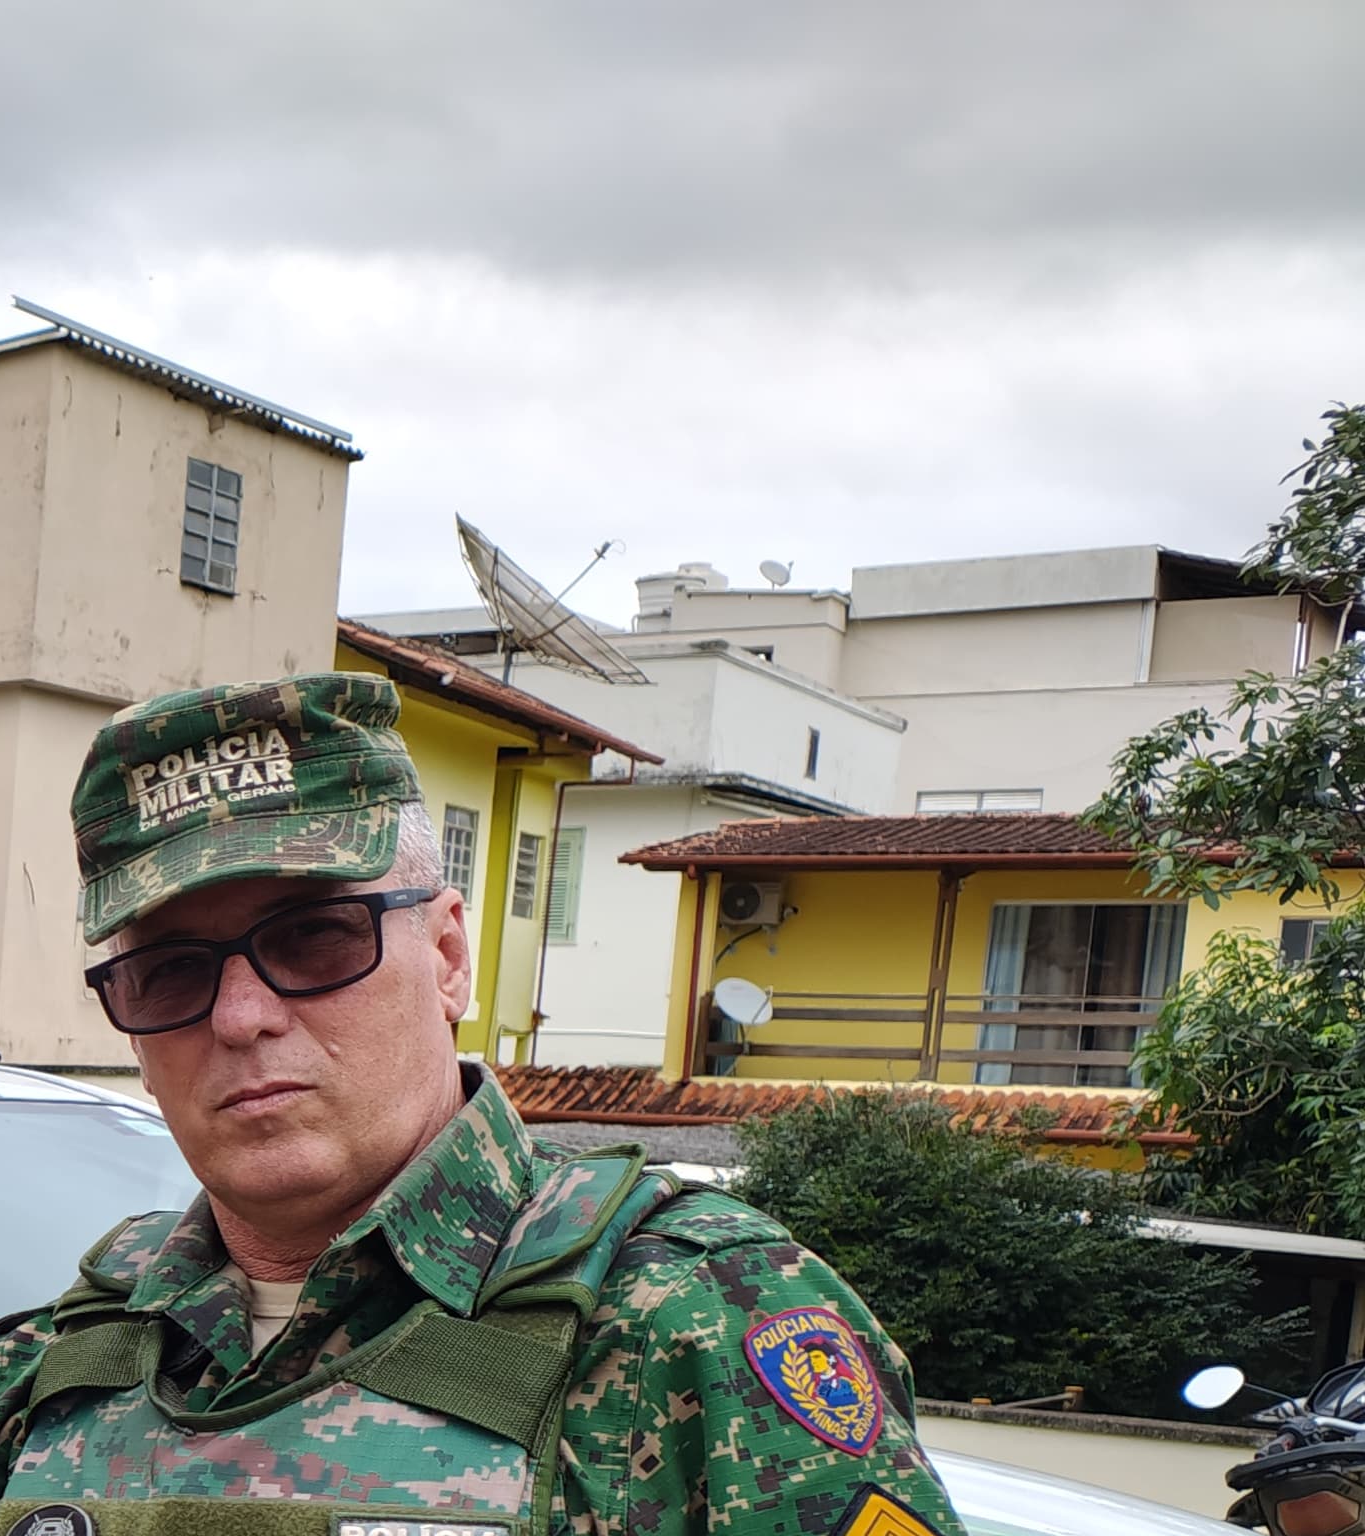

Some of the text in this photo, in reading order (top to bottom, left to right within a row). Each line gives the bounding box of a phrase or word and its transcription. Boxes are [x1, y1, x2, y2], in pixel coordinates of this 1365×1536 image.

[130, 727, 291, 791] POLÍCIA
[136, 758, 295, 820] MILITAR
[139, 784, 296, 832] DE MINAS GERAIS
[752, 1314, 812, 1359] POLÍCIA
[808, 1407, 850, 1441] MINAS
